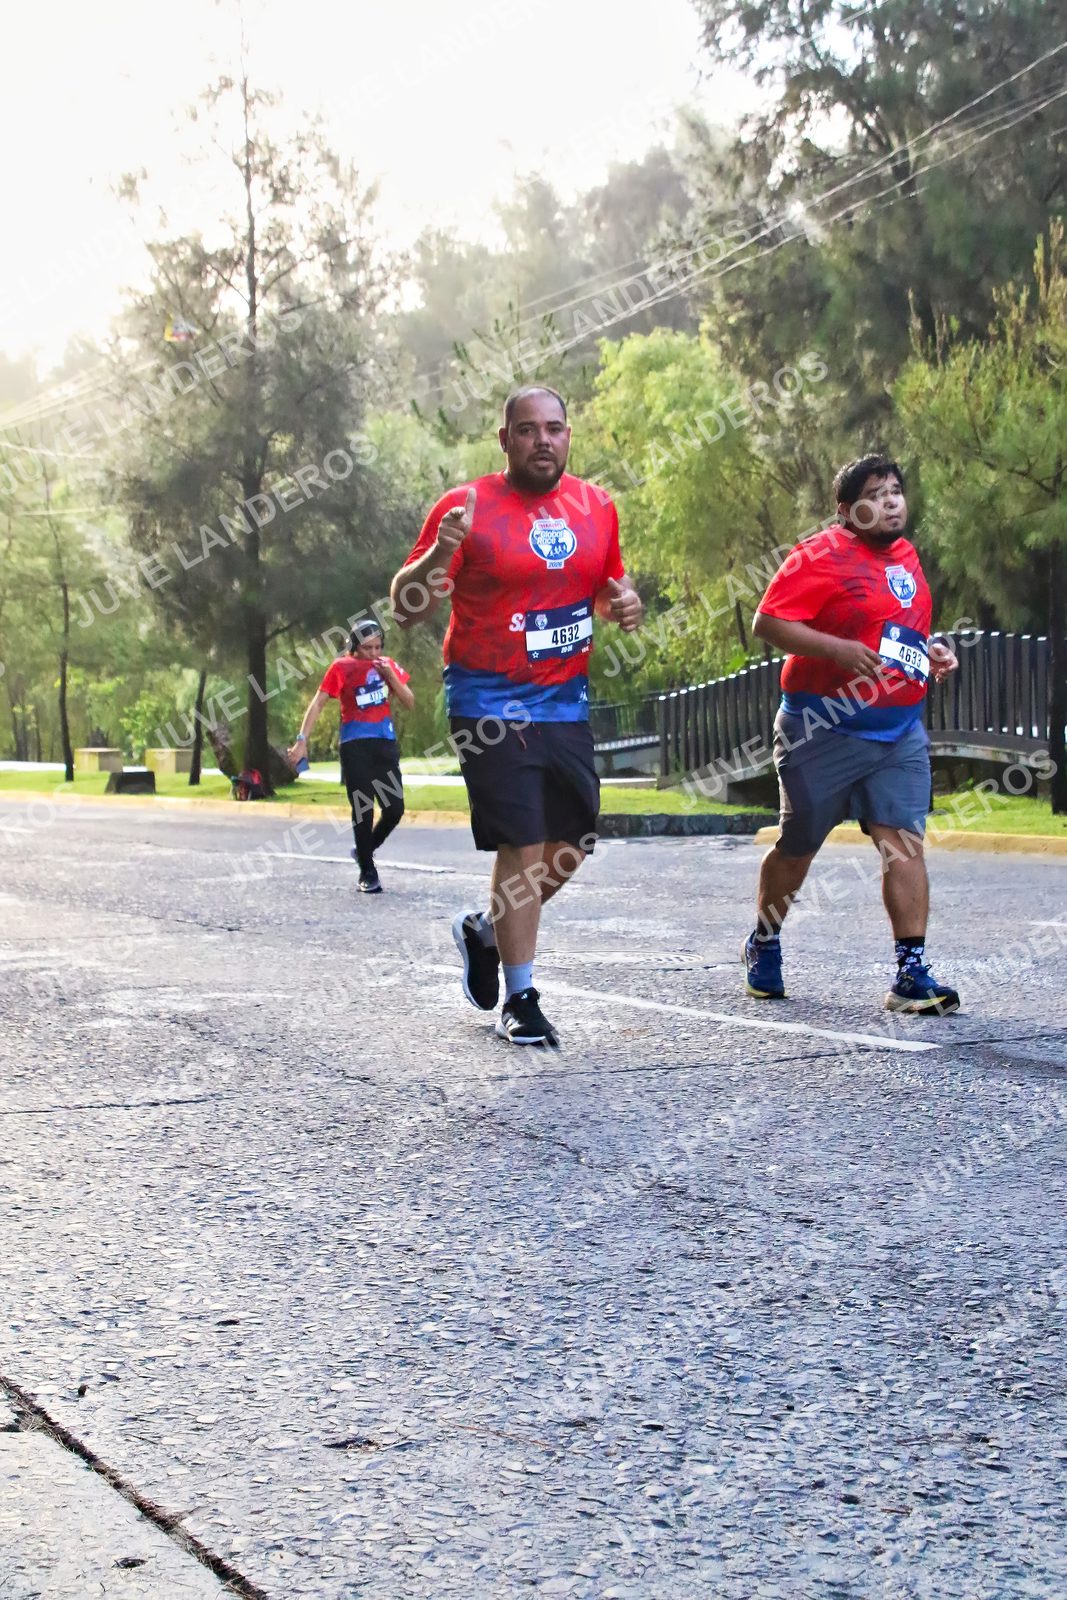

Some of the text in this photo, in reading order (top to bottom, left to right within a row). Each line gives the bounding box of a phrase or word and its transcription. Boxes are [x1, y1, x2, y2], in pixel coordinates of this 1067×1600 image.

[509, 613, 526, 631] S
[552, 624, 580, 645] 4632
[899, 646, 922, 668] 4633
